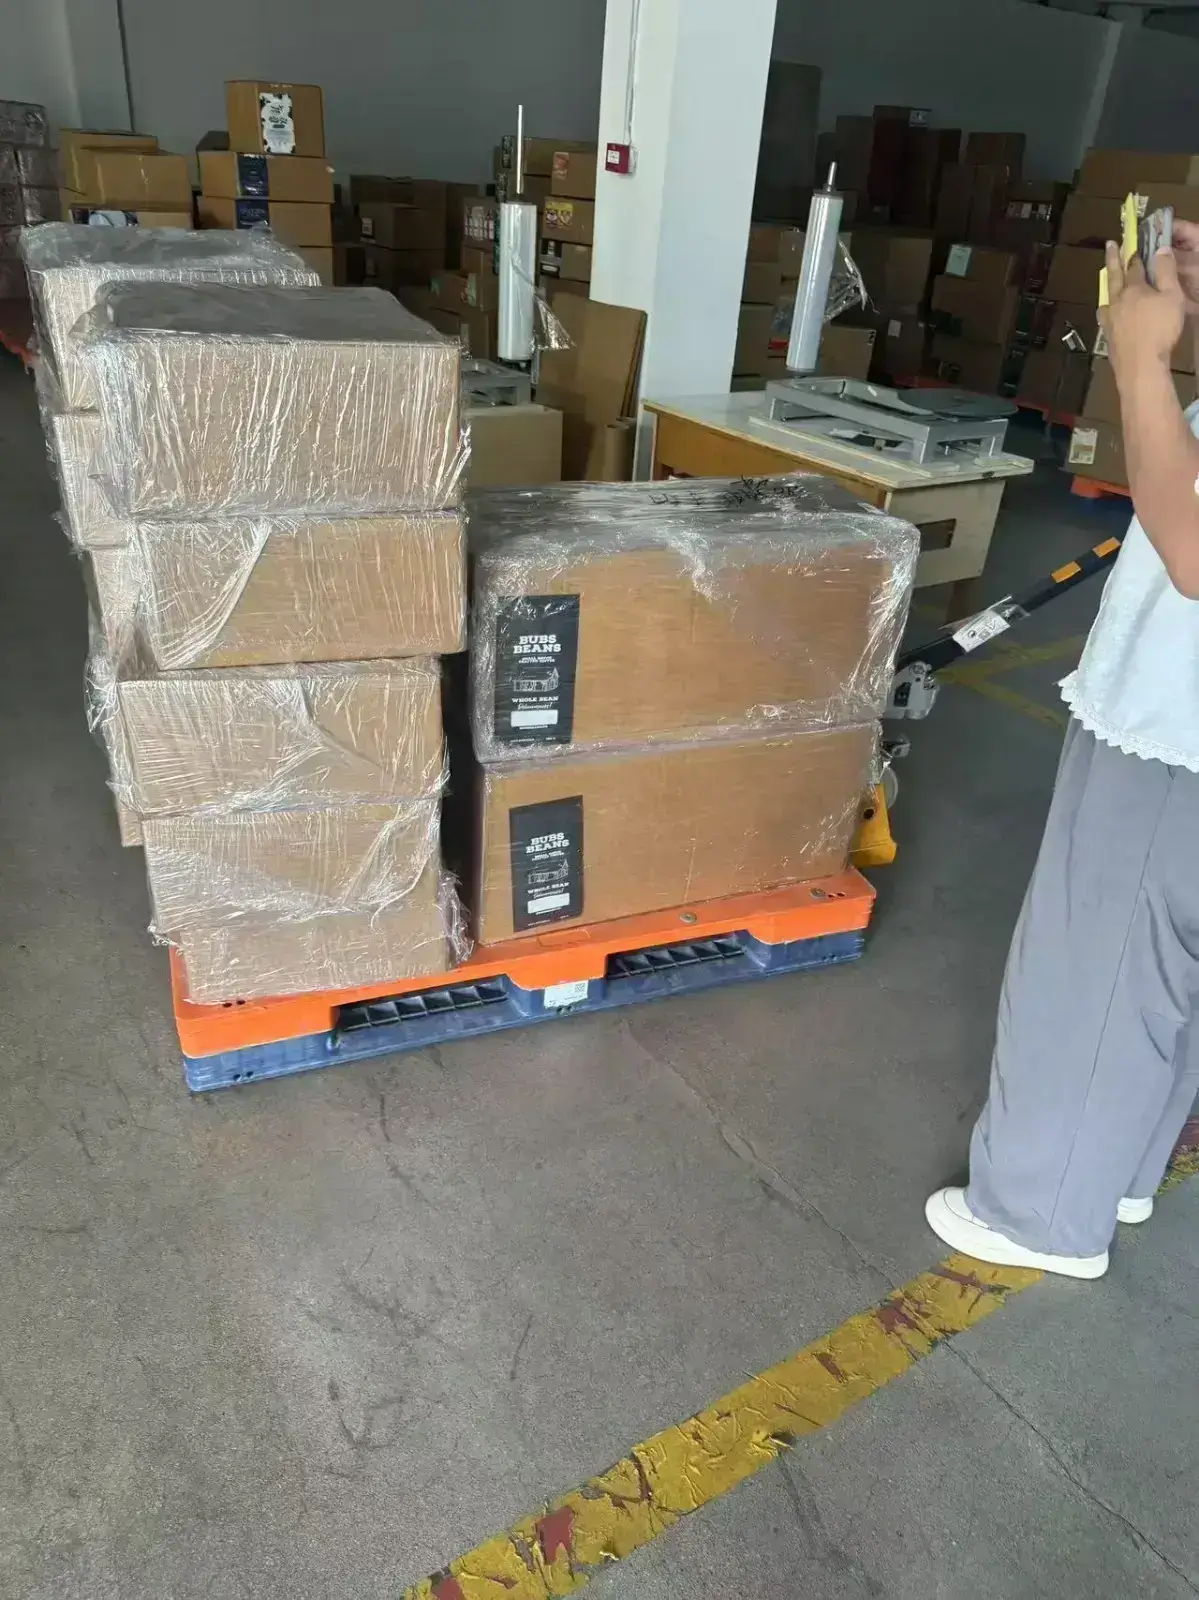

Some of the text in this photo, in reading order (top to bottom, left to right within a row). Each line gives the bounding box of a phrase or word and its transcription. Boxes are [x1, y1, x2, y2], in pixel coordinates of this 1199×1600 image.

[518, 634, 557, 645] BUBS
[513, 643, 562, 654] BEANS
[530, 832, 565, 846] BUBS
[525, 839, 570, 854] BEANS
